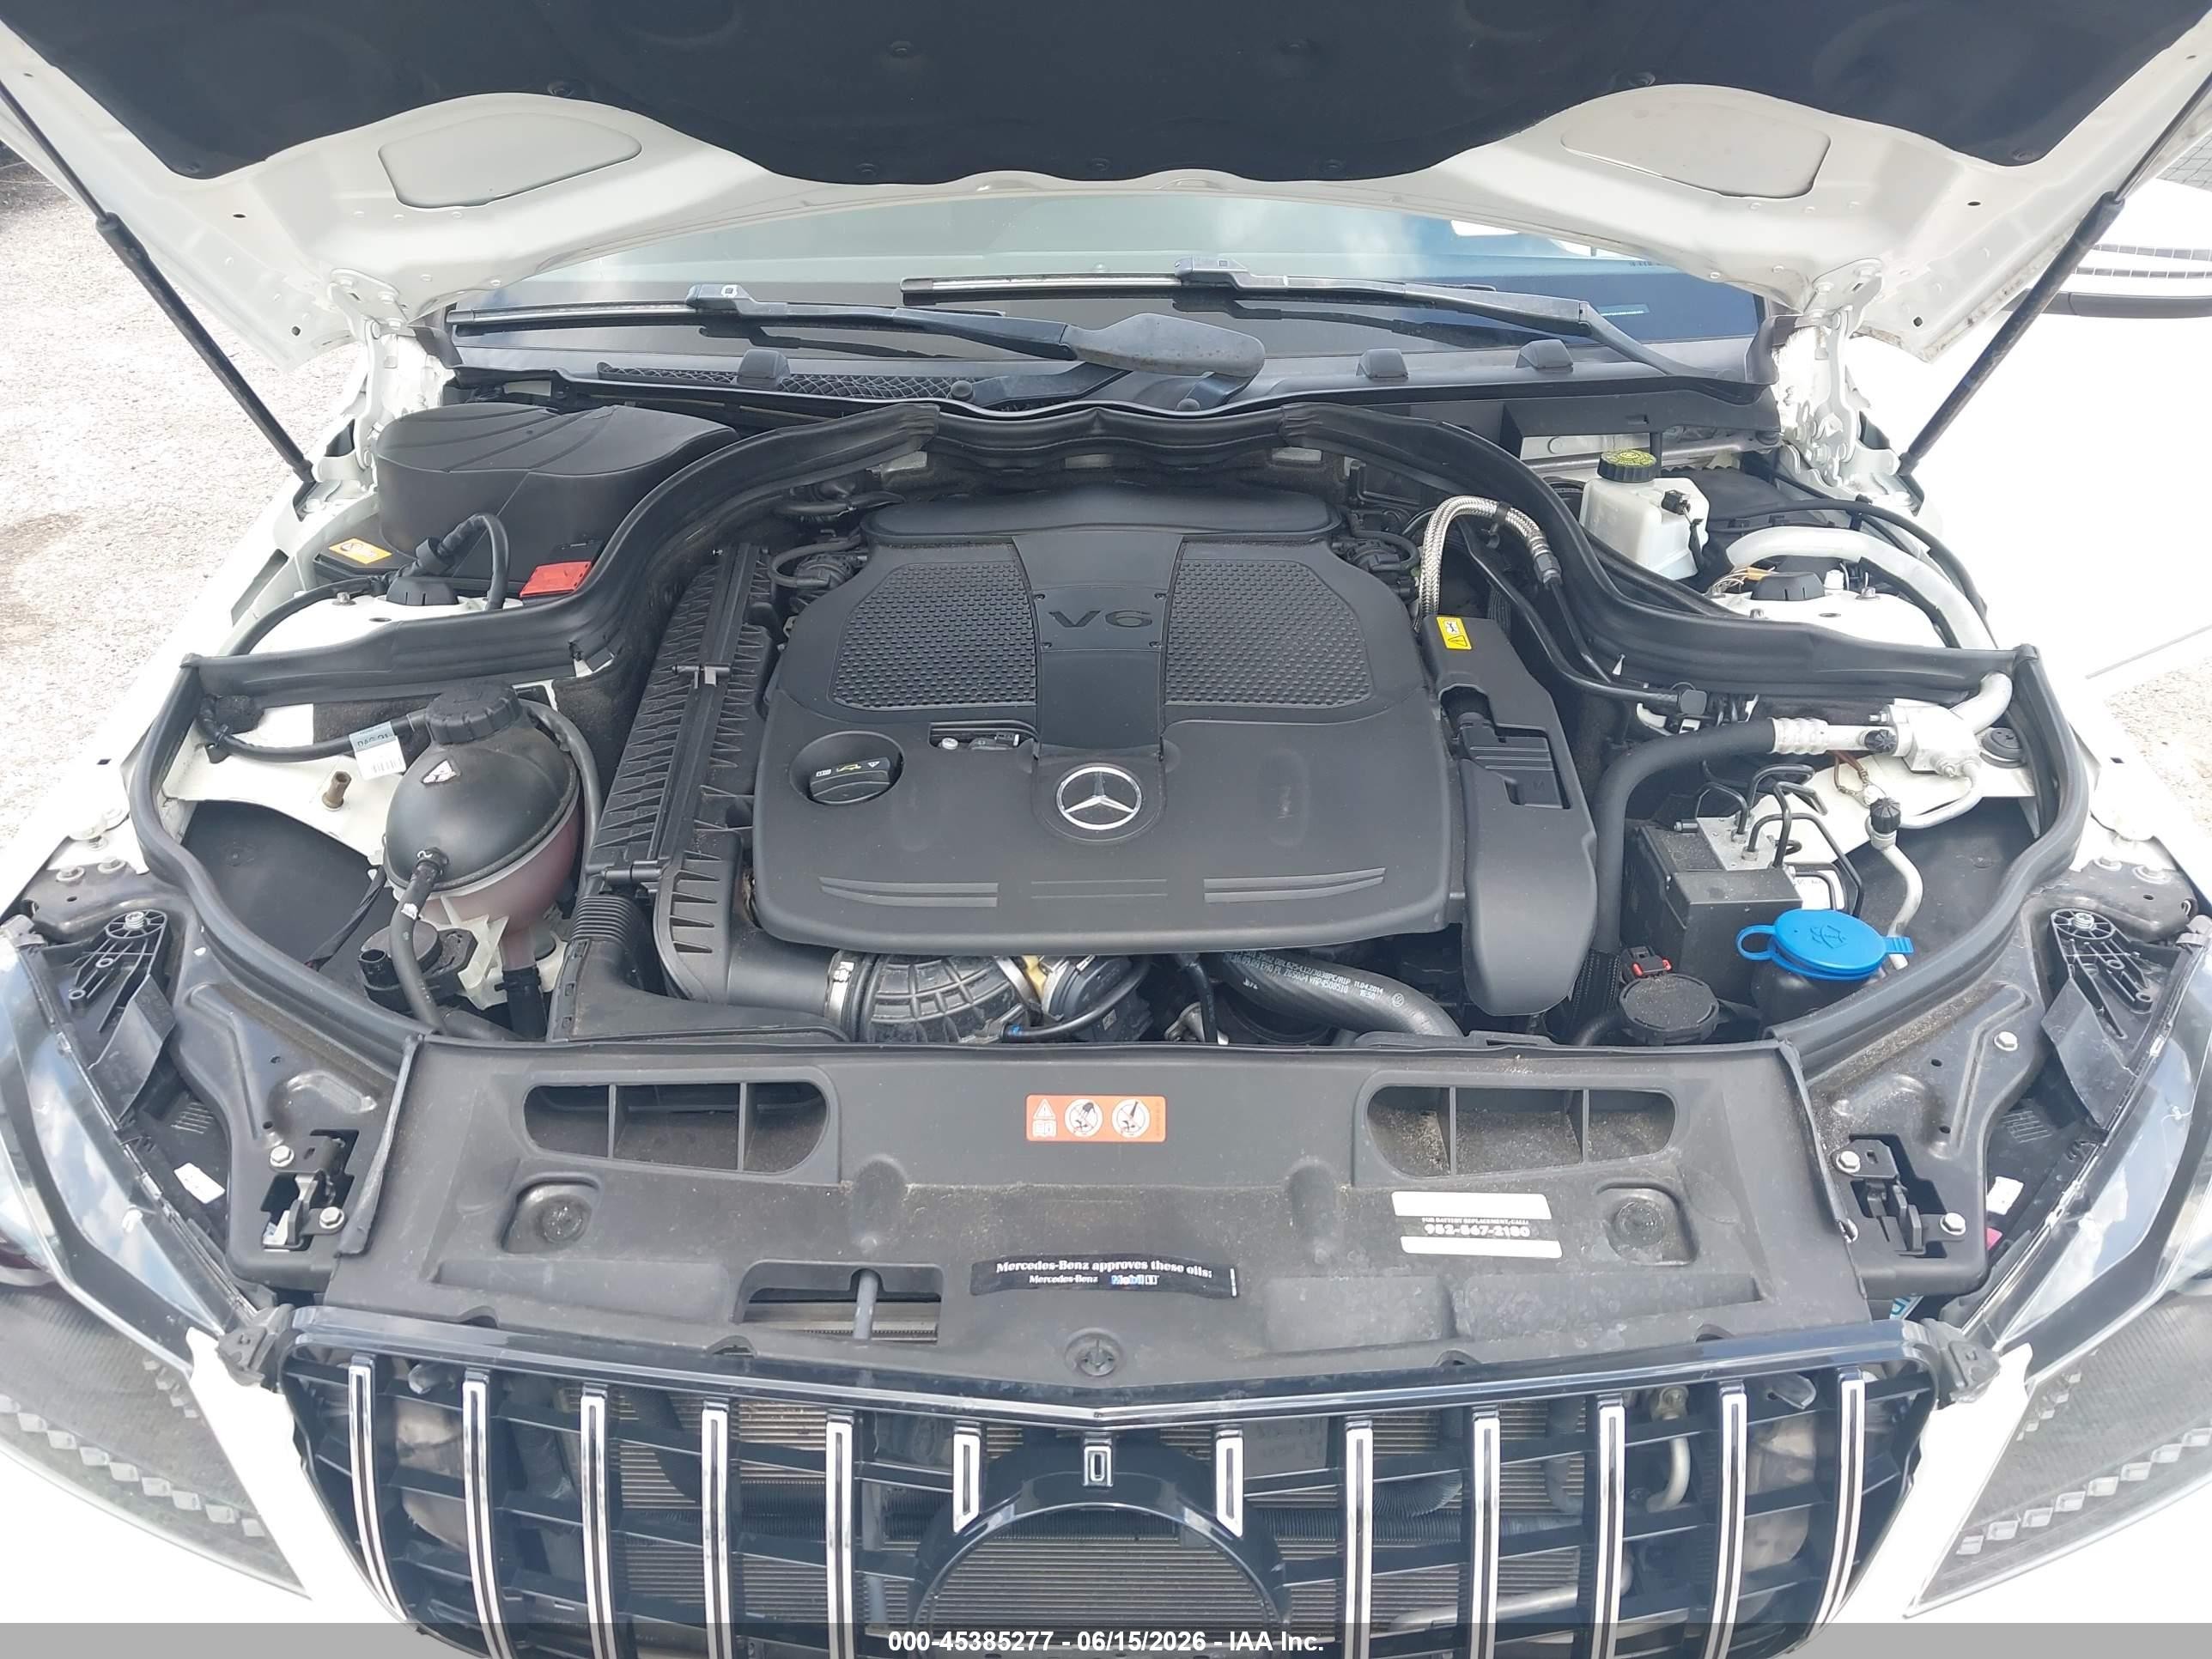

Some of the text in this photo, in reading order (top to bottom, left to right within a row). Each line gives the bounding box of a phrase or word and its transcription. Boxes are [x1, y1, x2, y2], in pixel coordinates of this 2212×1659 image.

[1048, 611, 1152, 628] V6
[996, 1260, 1212, 1278] Mercedes-Benz approves these oils:
[1029, 1275, 1098, 1285] Mercedes-Benz
[1111, 1275, 1145, 1285] Mobil
